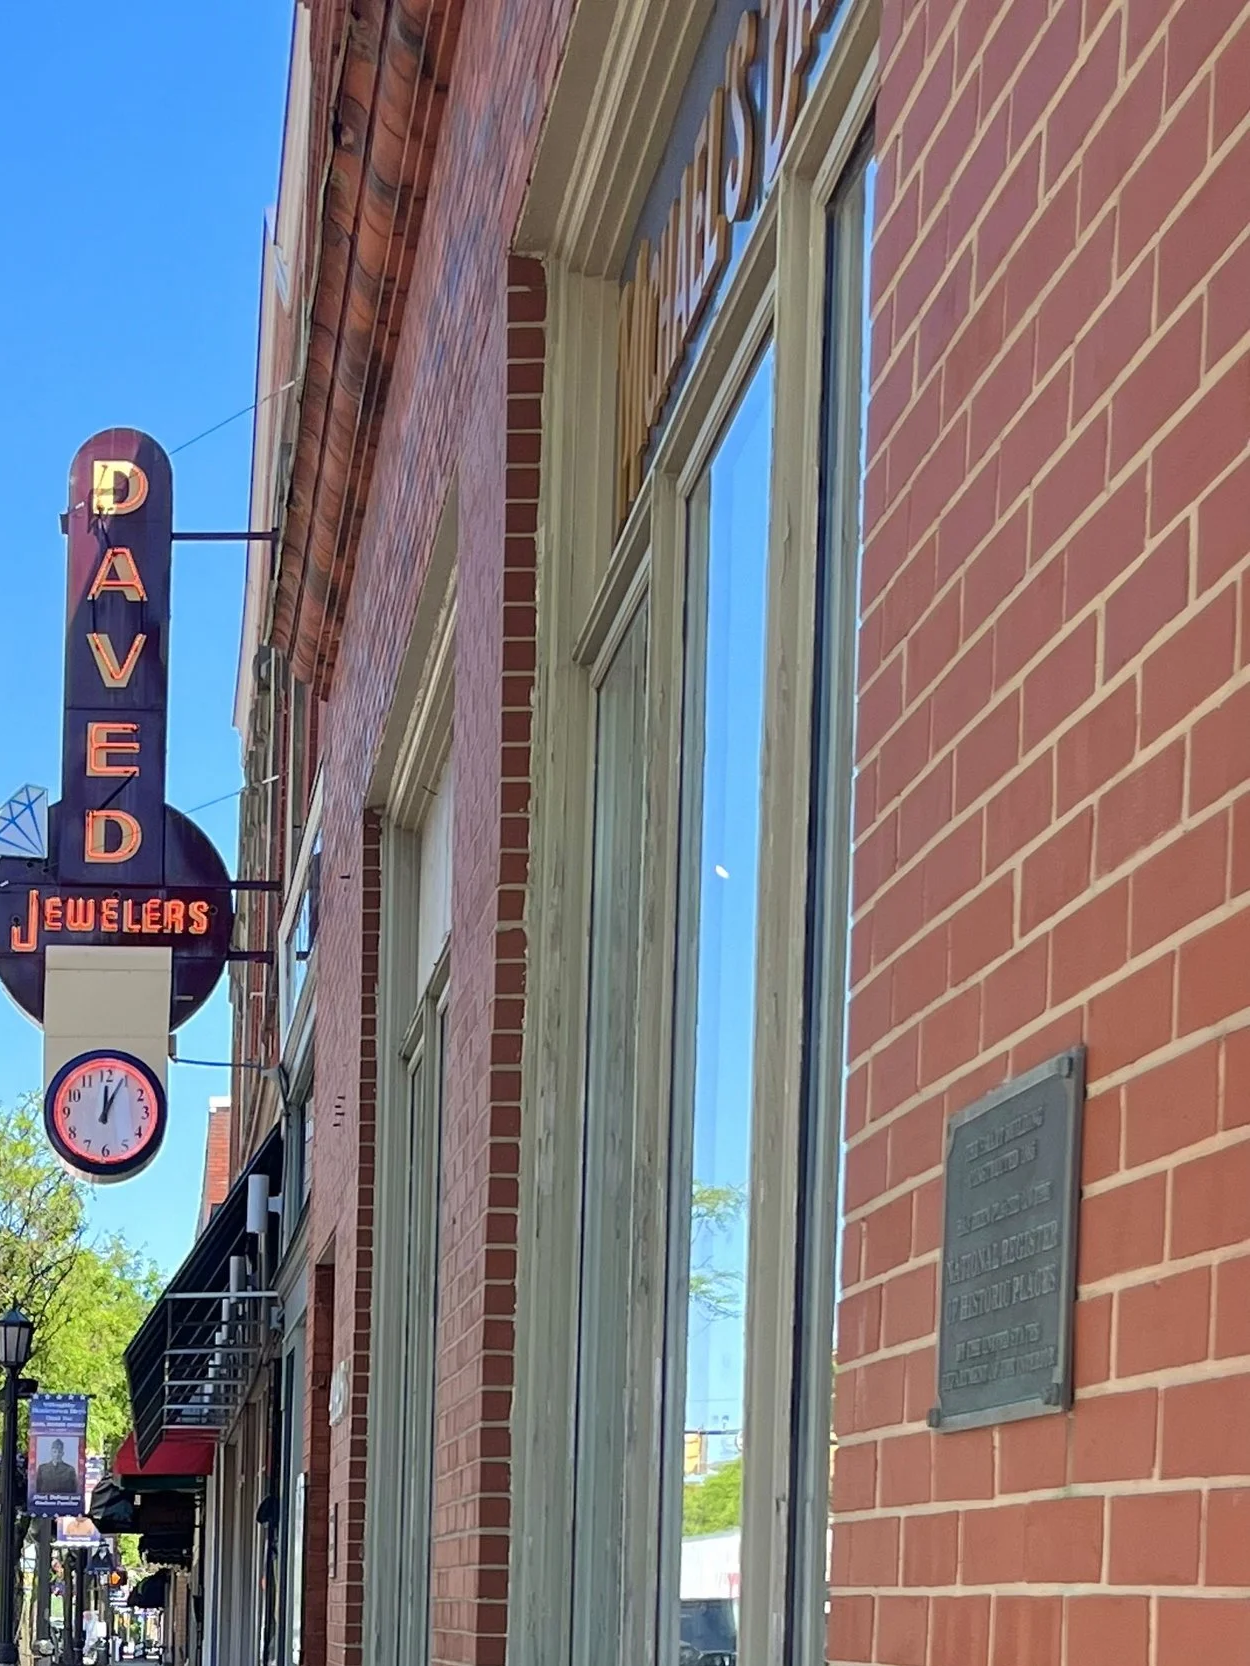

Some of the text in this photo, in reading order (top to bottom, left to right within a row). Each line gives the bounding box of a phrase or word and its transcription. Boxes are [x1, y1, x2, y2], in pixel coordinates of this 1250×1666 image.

[84, 460, 149, 864] DAVED
[11, 889, 211, 953] JEWELERS
[81, 1075, 93, 1088] 11
[99, 1069, 114, 1083] 12
[68, 1089, 81, 1103] 10
[137, 1088, 144, 1102] 2
[62, 1106, 71, 1119] 9
[141, 1105, 150, 1120] 3
[68, 1126, 77, 1140] 8
[134, 1126, 143, 1138] 4
[101, 1143, 110, 1157] 6
